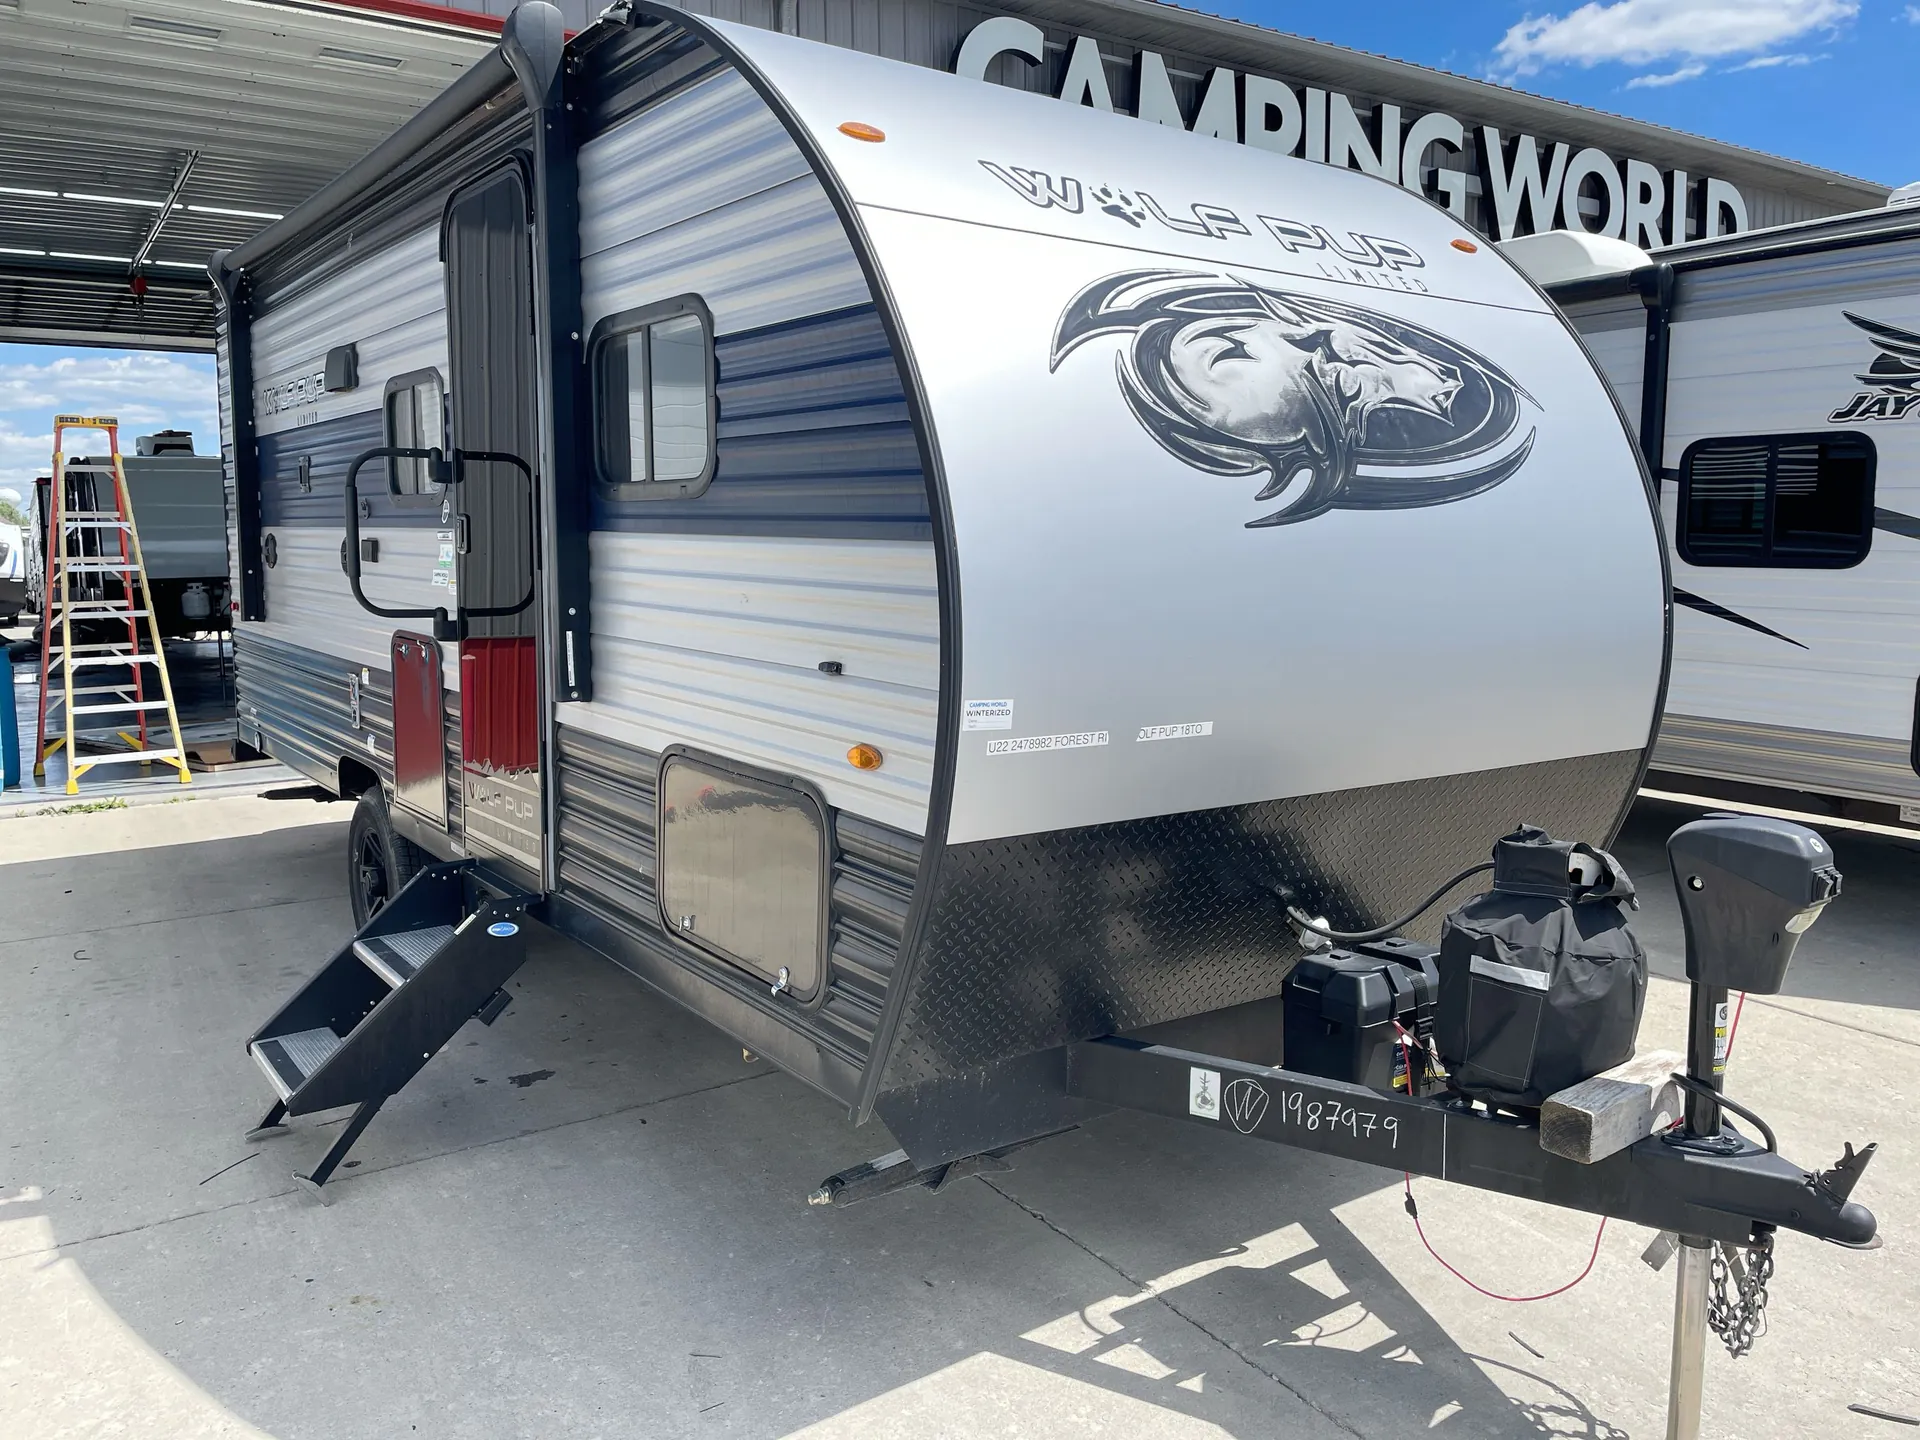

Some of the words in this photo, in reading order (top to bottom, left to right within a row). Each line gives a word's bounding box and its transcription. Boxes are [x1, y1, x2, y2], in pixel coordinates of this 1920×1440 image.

[1482, 125, 1749, 249] WORLD
[1256, 214, 1426, 271] PUP
[1316, 262, 1428, 293] LIMITED
[1827, 392, 1920, 423] JAY
[966, 709, 1011, 717] WINTERIZED
[988, 740, 1009, 753] U22
[1011, 737, 1052, 751] 2478982
[1054, 733, 1096, 748] FOREST
[1158, 726, 1178, 737] PUP
[505, 795, 534, 820] PUP
[1282, 1090, 1399, 1149] 1987979
